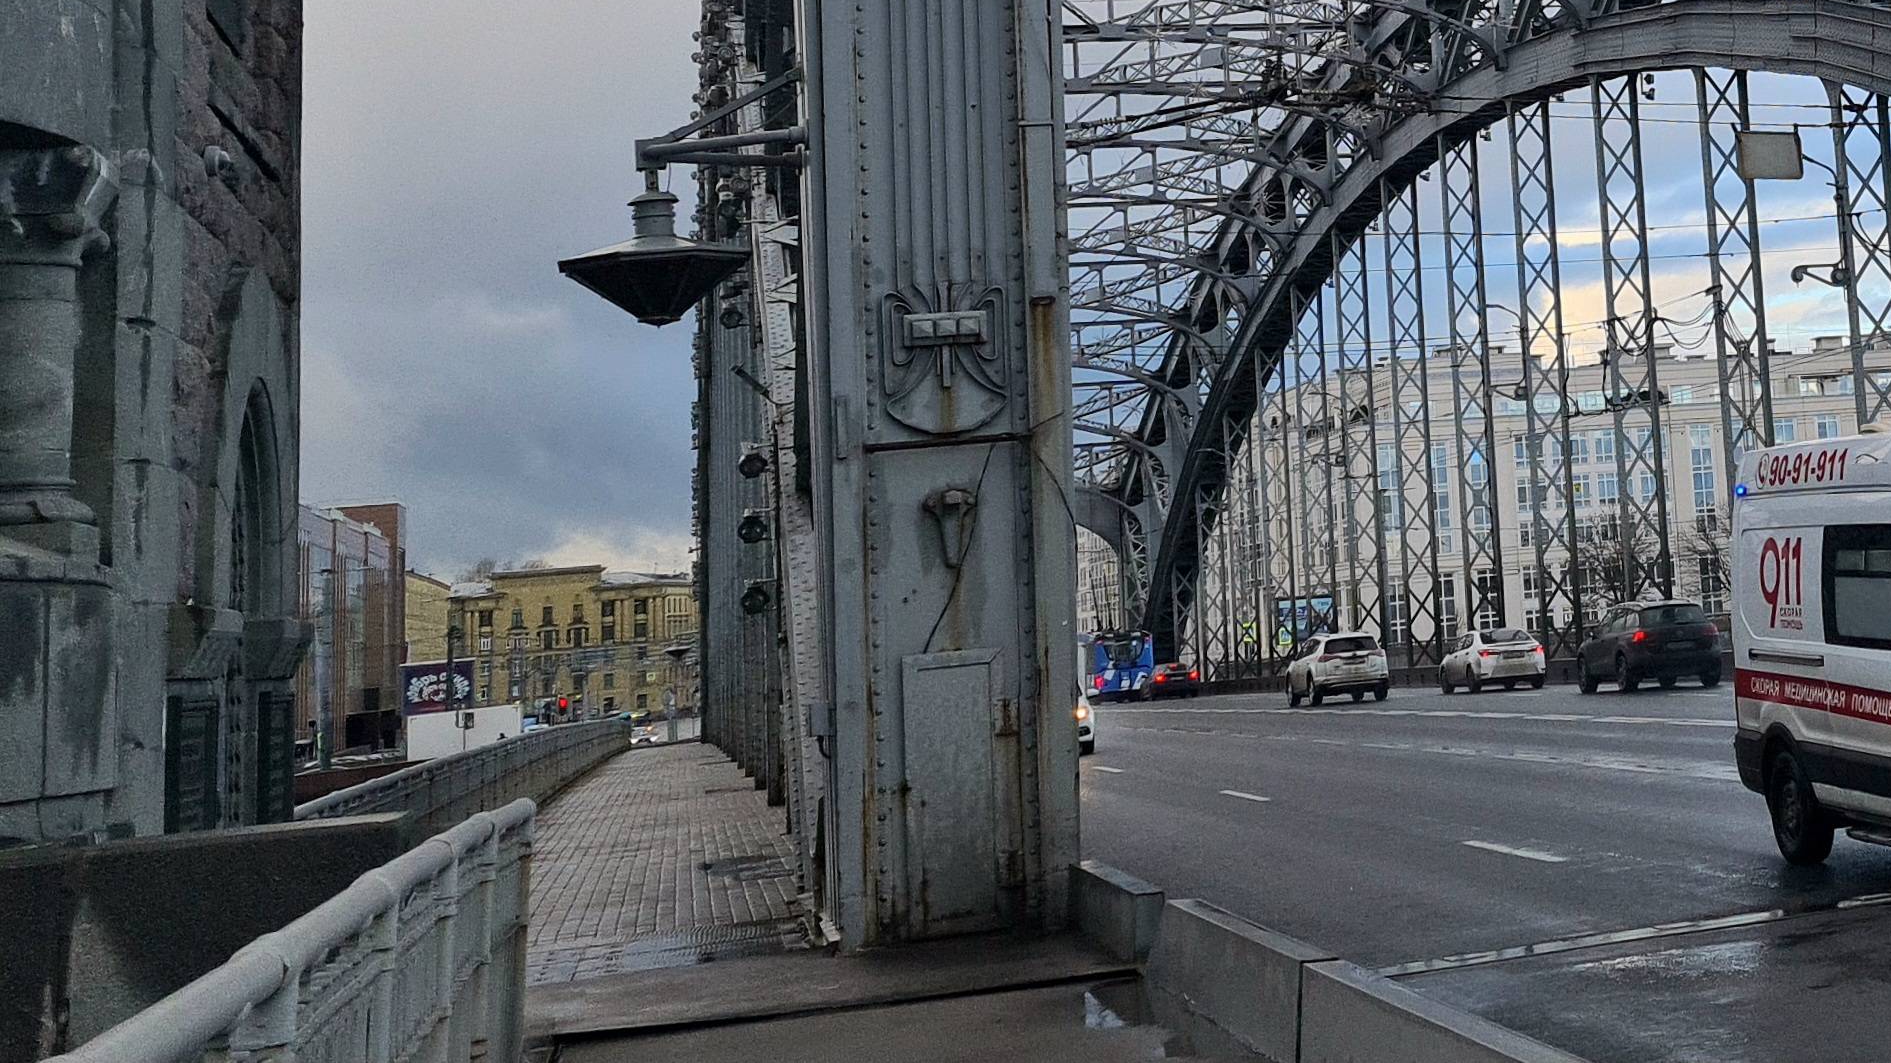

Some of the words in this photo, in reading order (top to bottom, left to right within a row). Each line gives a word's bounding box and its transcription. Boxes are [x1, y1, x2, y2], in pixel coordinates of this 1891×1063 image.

[1769, 448, 1849, 486] 90-91-911
[1760, 537, 1802, 628] 911
[1750, 677, 1780, 696] СКОРАЯ
[1784, 682, 1846, 708] МЕДИЦИНСКАЯ
